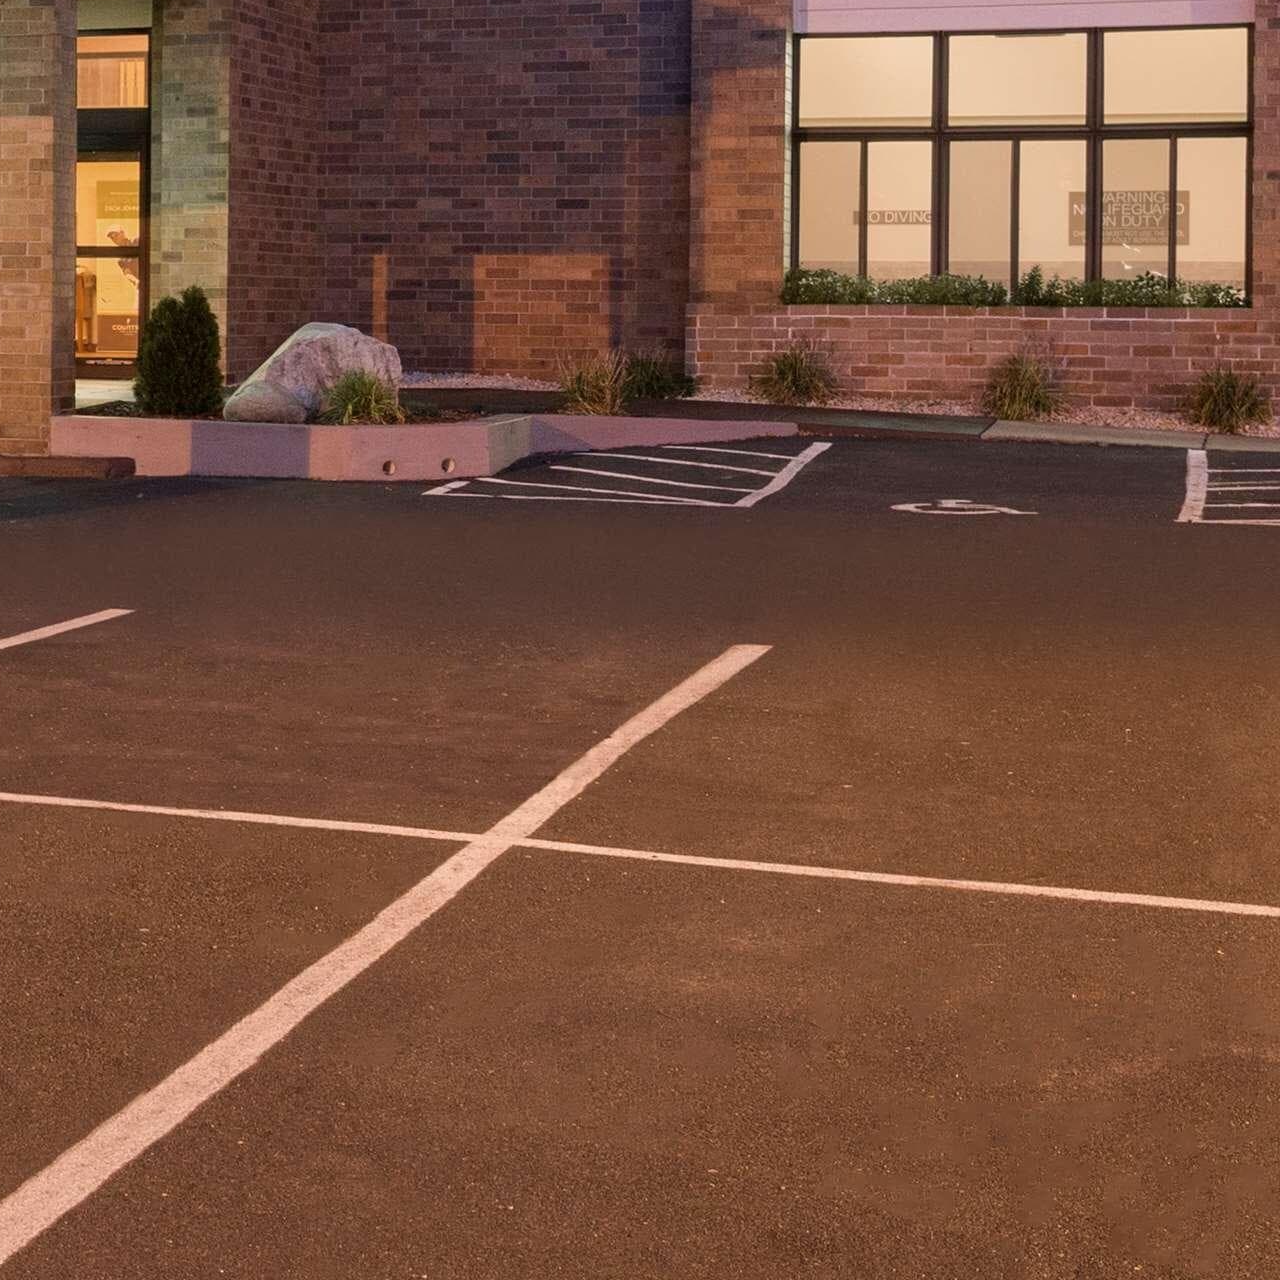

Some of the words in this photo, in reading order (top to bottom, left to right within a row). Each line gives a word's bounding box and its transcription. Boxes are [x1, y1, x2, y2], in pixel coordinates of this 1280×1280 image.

[1101, 191, 1166, 203] ARNING
[884, 210, 932, 224] DIVING
[1120, 215, 1162, 227] DUTY
